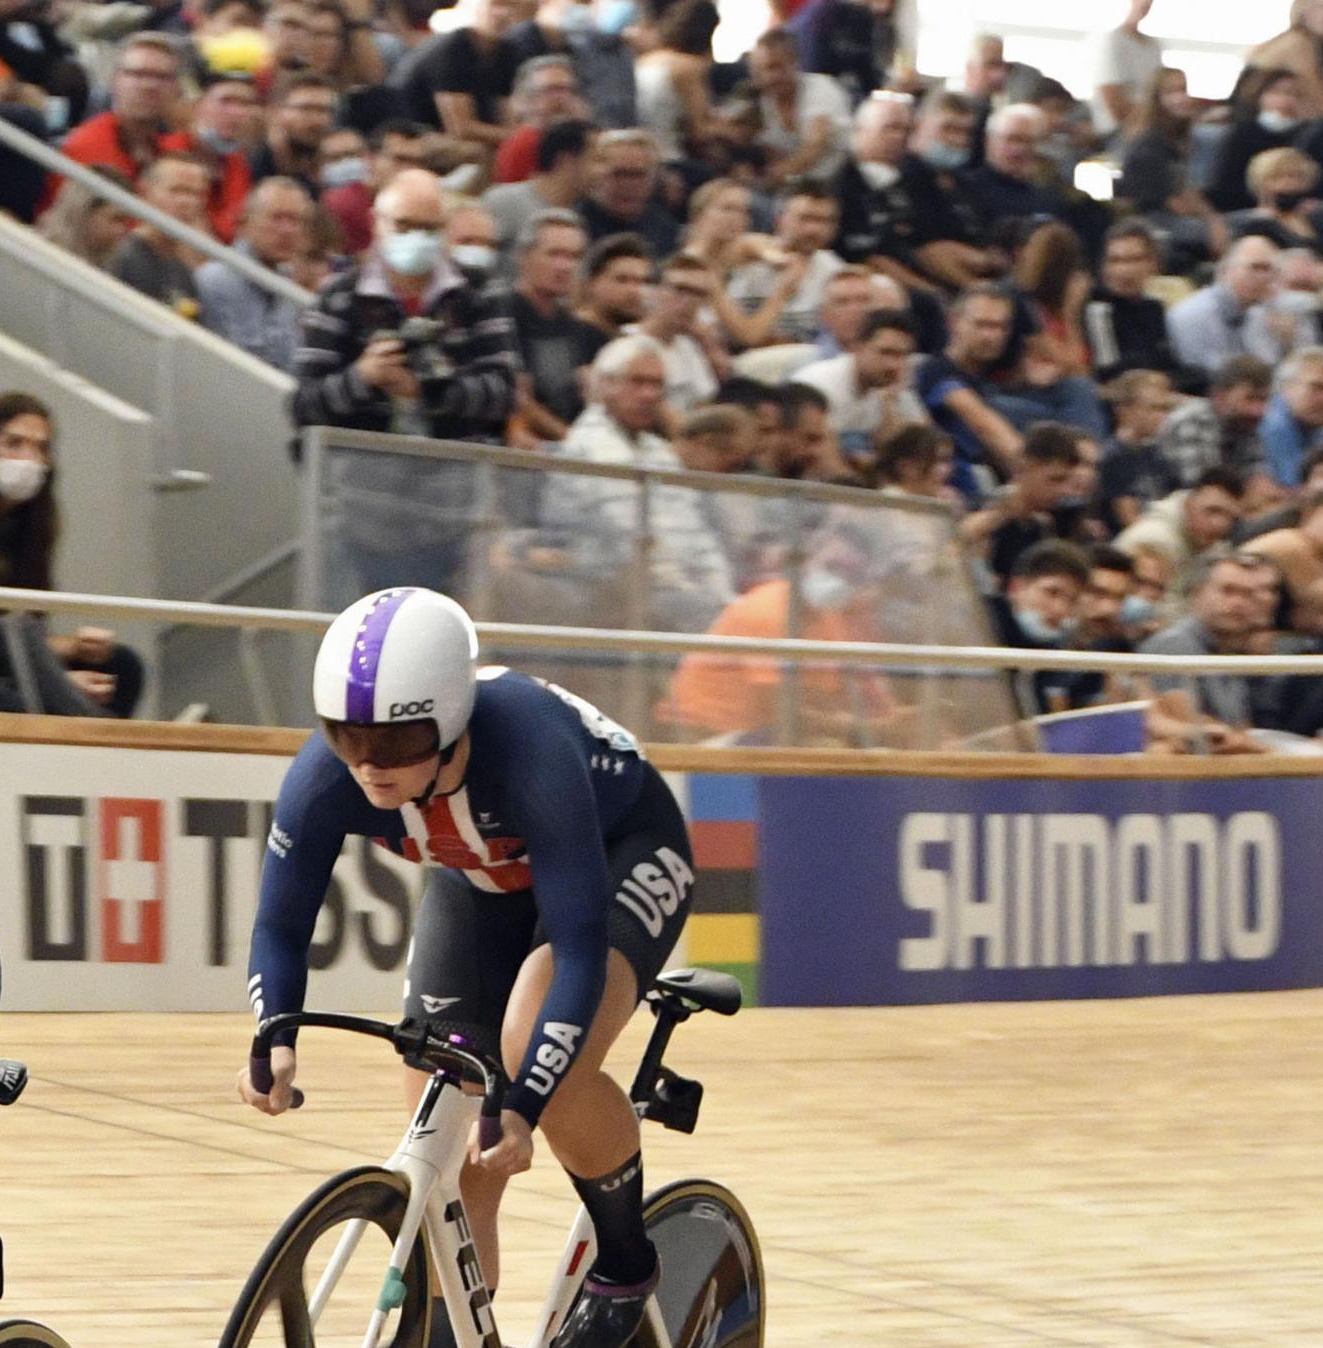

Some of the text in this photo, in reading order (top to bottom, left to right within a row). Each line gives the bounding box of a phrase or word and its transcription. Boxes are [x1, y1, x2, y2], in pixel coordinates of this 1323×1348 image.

[616, 846, 695, 939] USA
[897, 811, 1281, 971] SHIMANO
[526, 1021, 583, 1097] USA
